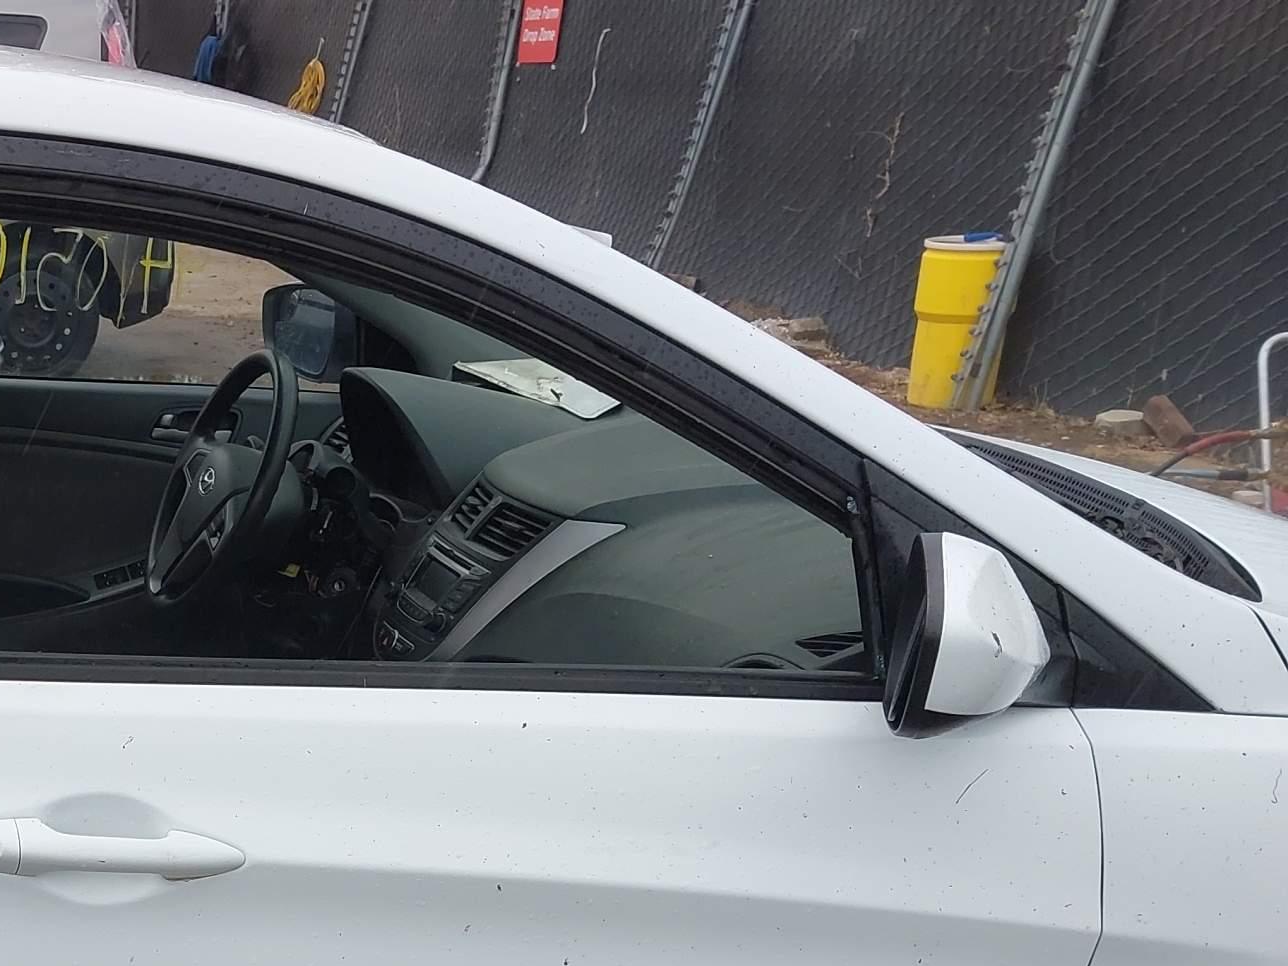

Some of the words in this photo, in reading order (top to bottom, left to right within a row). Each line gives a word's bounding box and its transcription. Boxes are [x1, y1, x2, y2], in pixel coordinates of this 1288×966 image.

[525, 7, 541, 20] State
[542, 5, 559, 19] Farm
[523, 29, 538, 45] Drop
[539, 28, 555, 41] Zone
